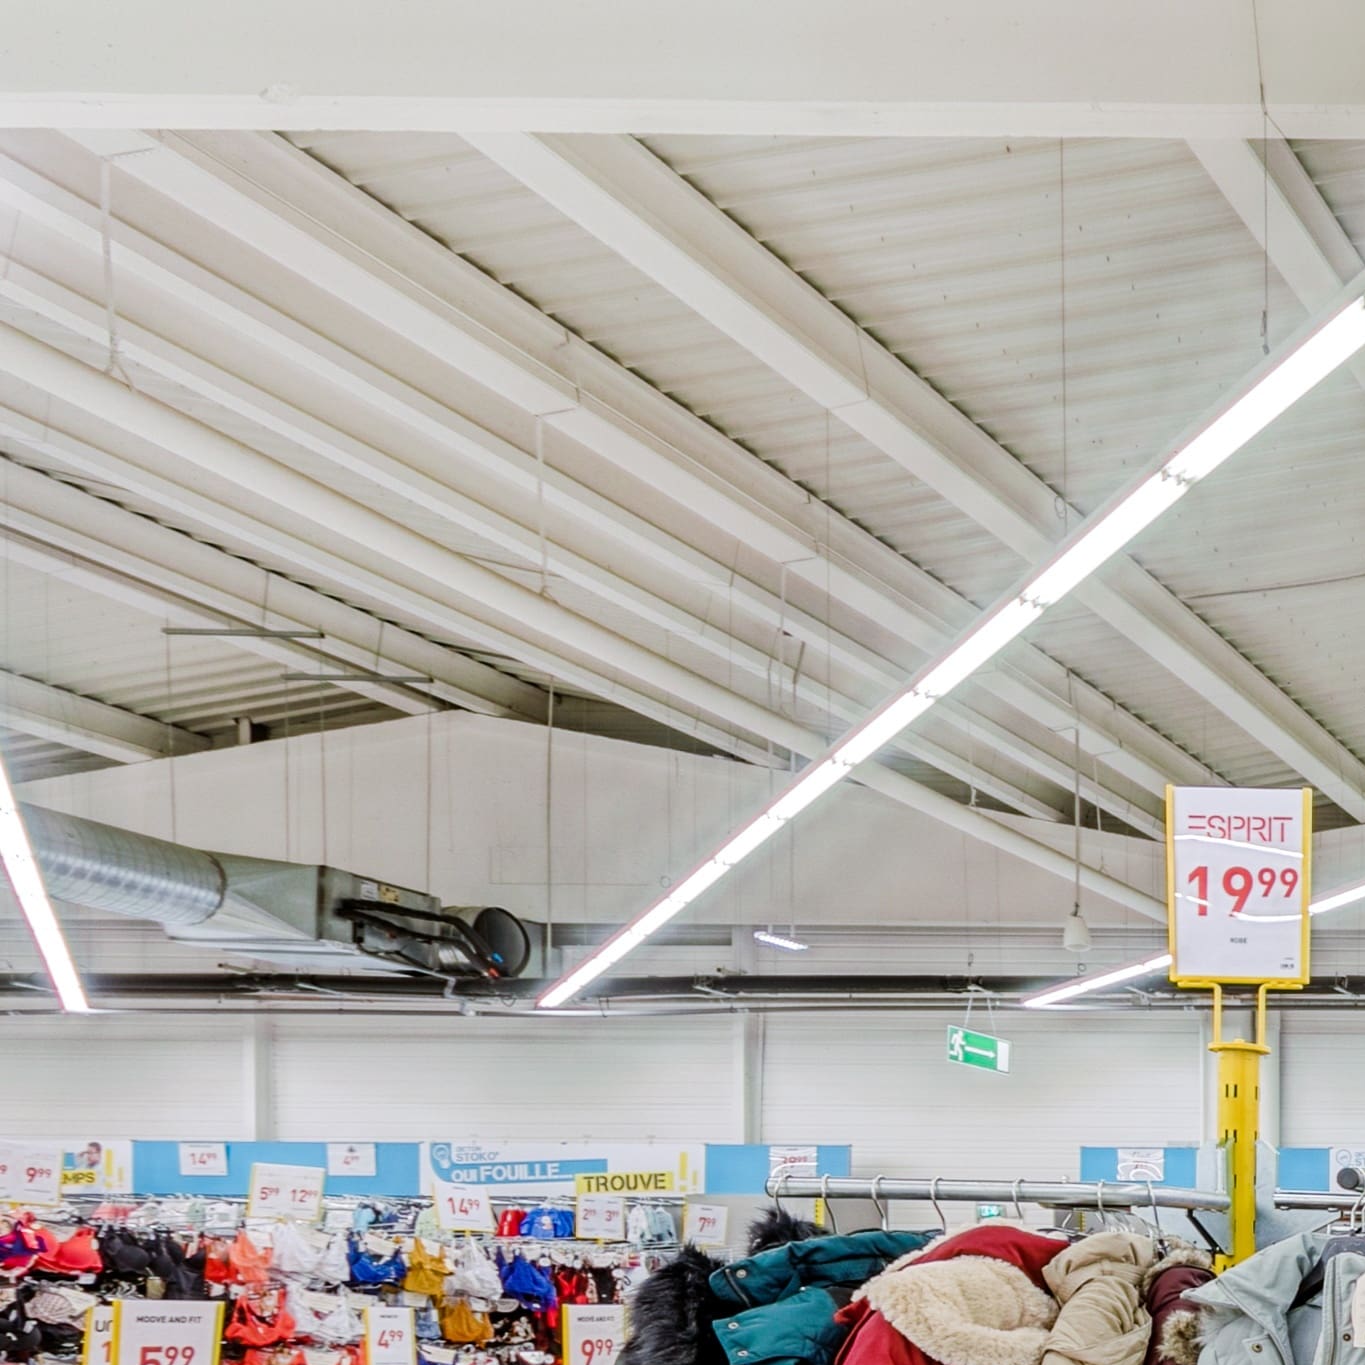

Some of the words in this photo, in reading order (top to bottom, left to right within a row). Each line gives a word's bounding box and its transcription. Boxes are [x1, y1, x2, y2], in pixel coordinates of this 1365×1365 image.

[1188, 815, 1293, 842] ESPRIT
[1188, 866, 1298, 917] 1999
[452, 1169, 477, 1182] QUI
[583, 1173, 666, 1192] TROUVE
[448, 1197, 480, 1216] 1499
[377, 1330, 403, 1349] 499
